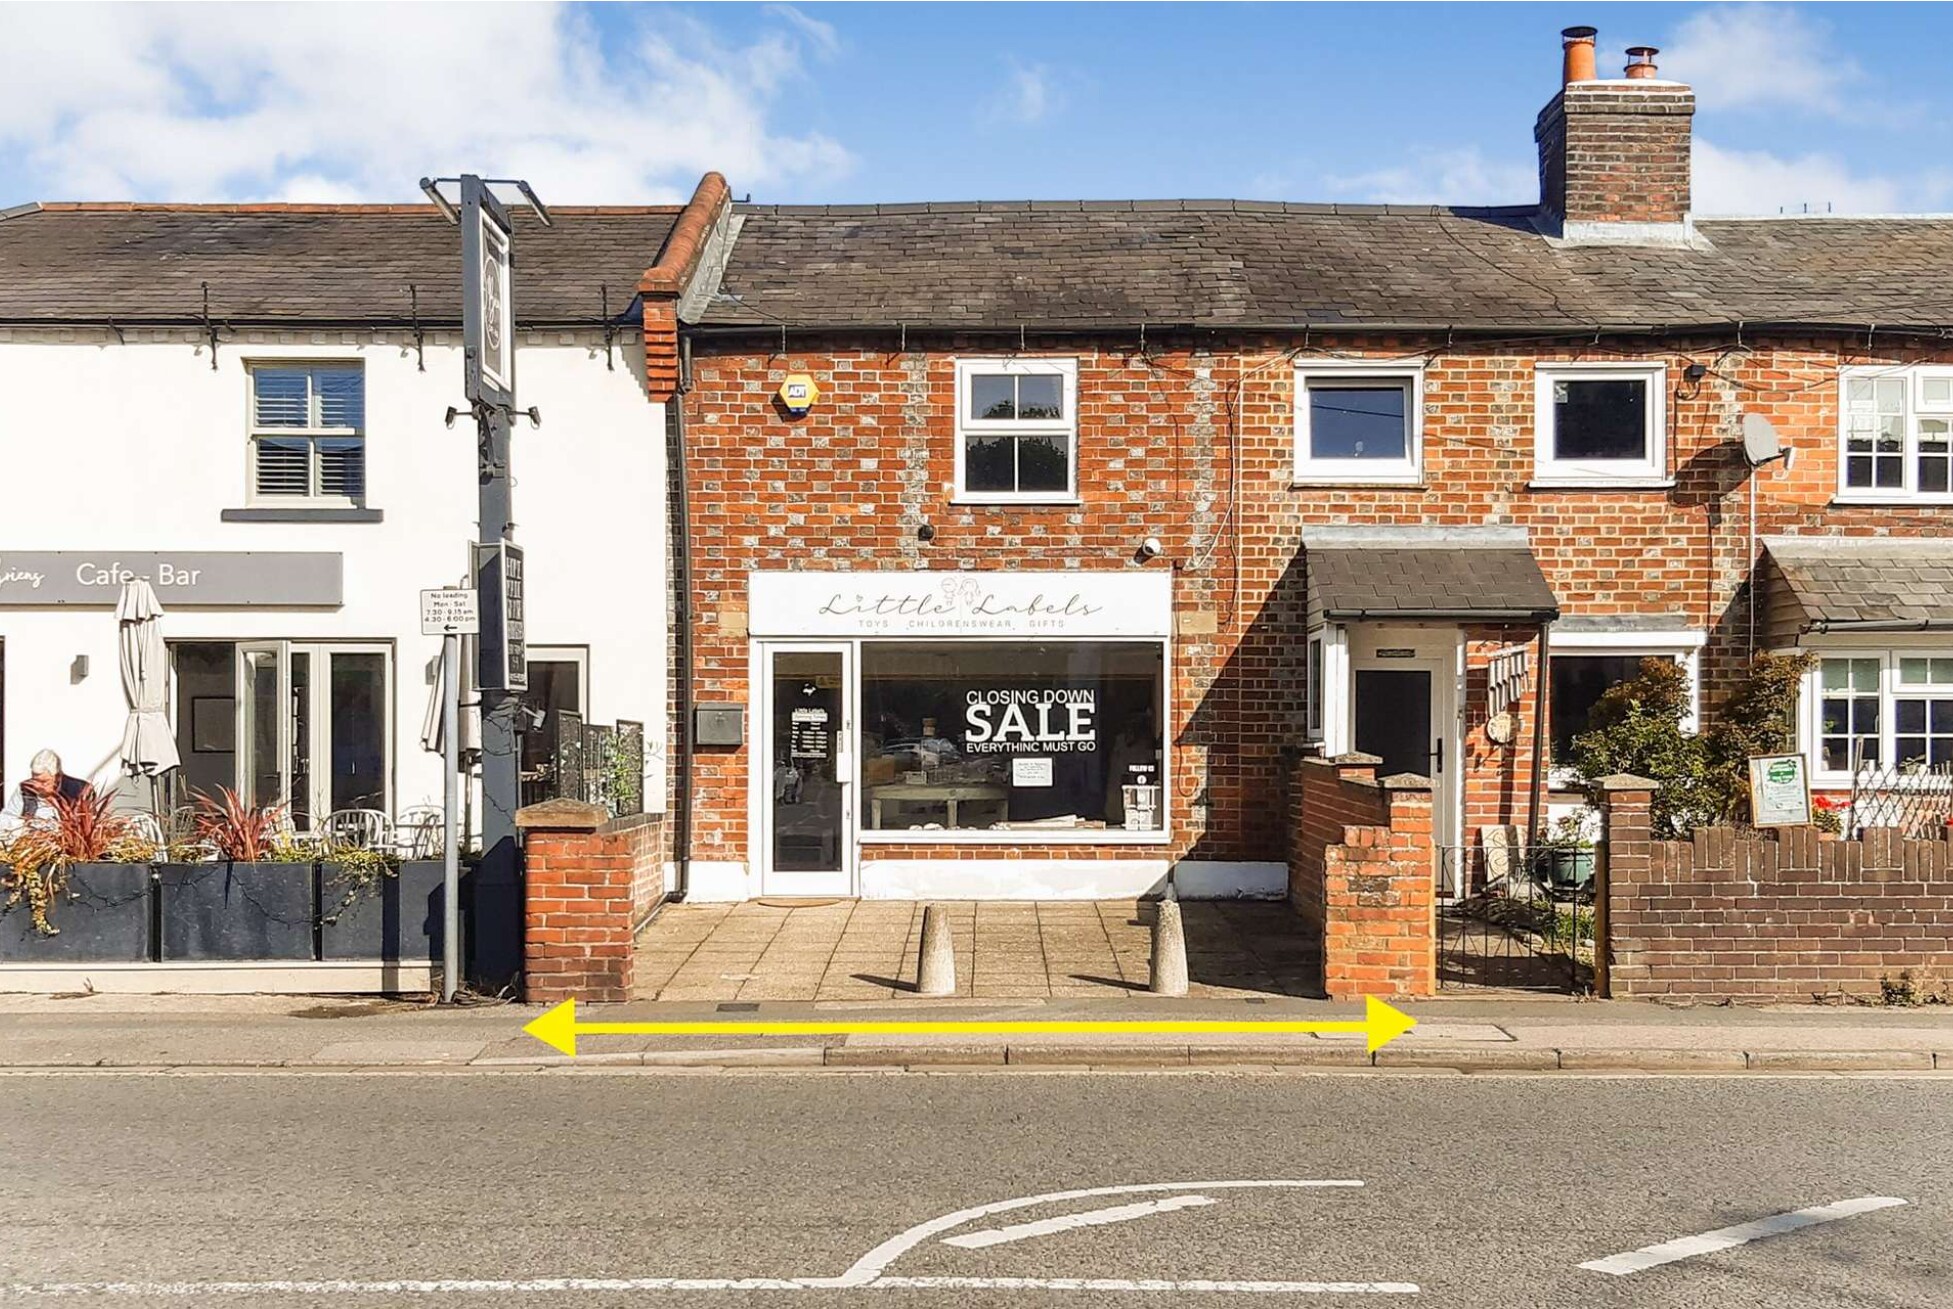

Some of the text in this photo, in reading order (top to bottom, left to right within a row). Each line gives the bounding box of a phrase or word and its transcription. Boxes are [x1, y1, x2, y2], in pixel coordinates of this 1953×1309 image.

[789, 386, 806, 397] ADT
[76, 562, 134, 585] Cafe
[158, 563, 201, 586] Bar
[819, 594, 1103, 615] Little Labels
[859, 620, 889, 628] TOYS
[1029, 620, 1065, 628] GIFTS
[966, 689, 1094, 705] CLOSING DOWN
[965, 702, 1096, 742] SALE
[1043, 742, 1075, 752] MUST
[1078, 741, 1096, 752] GO
